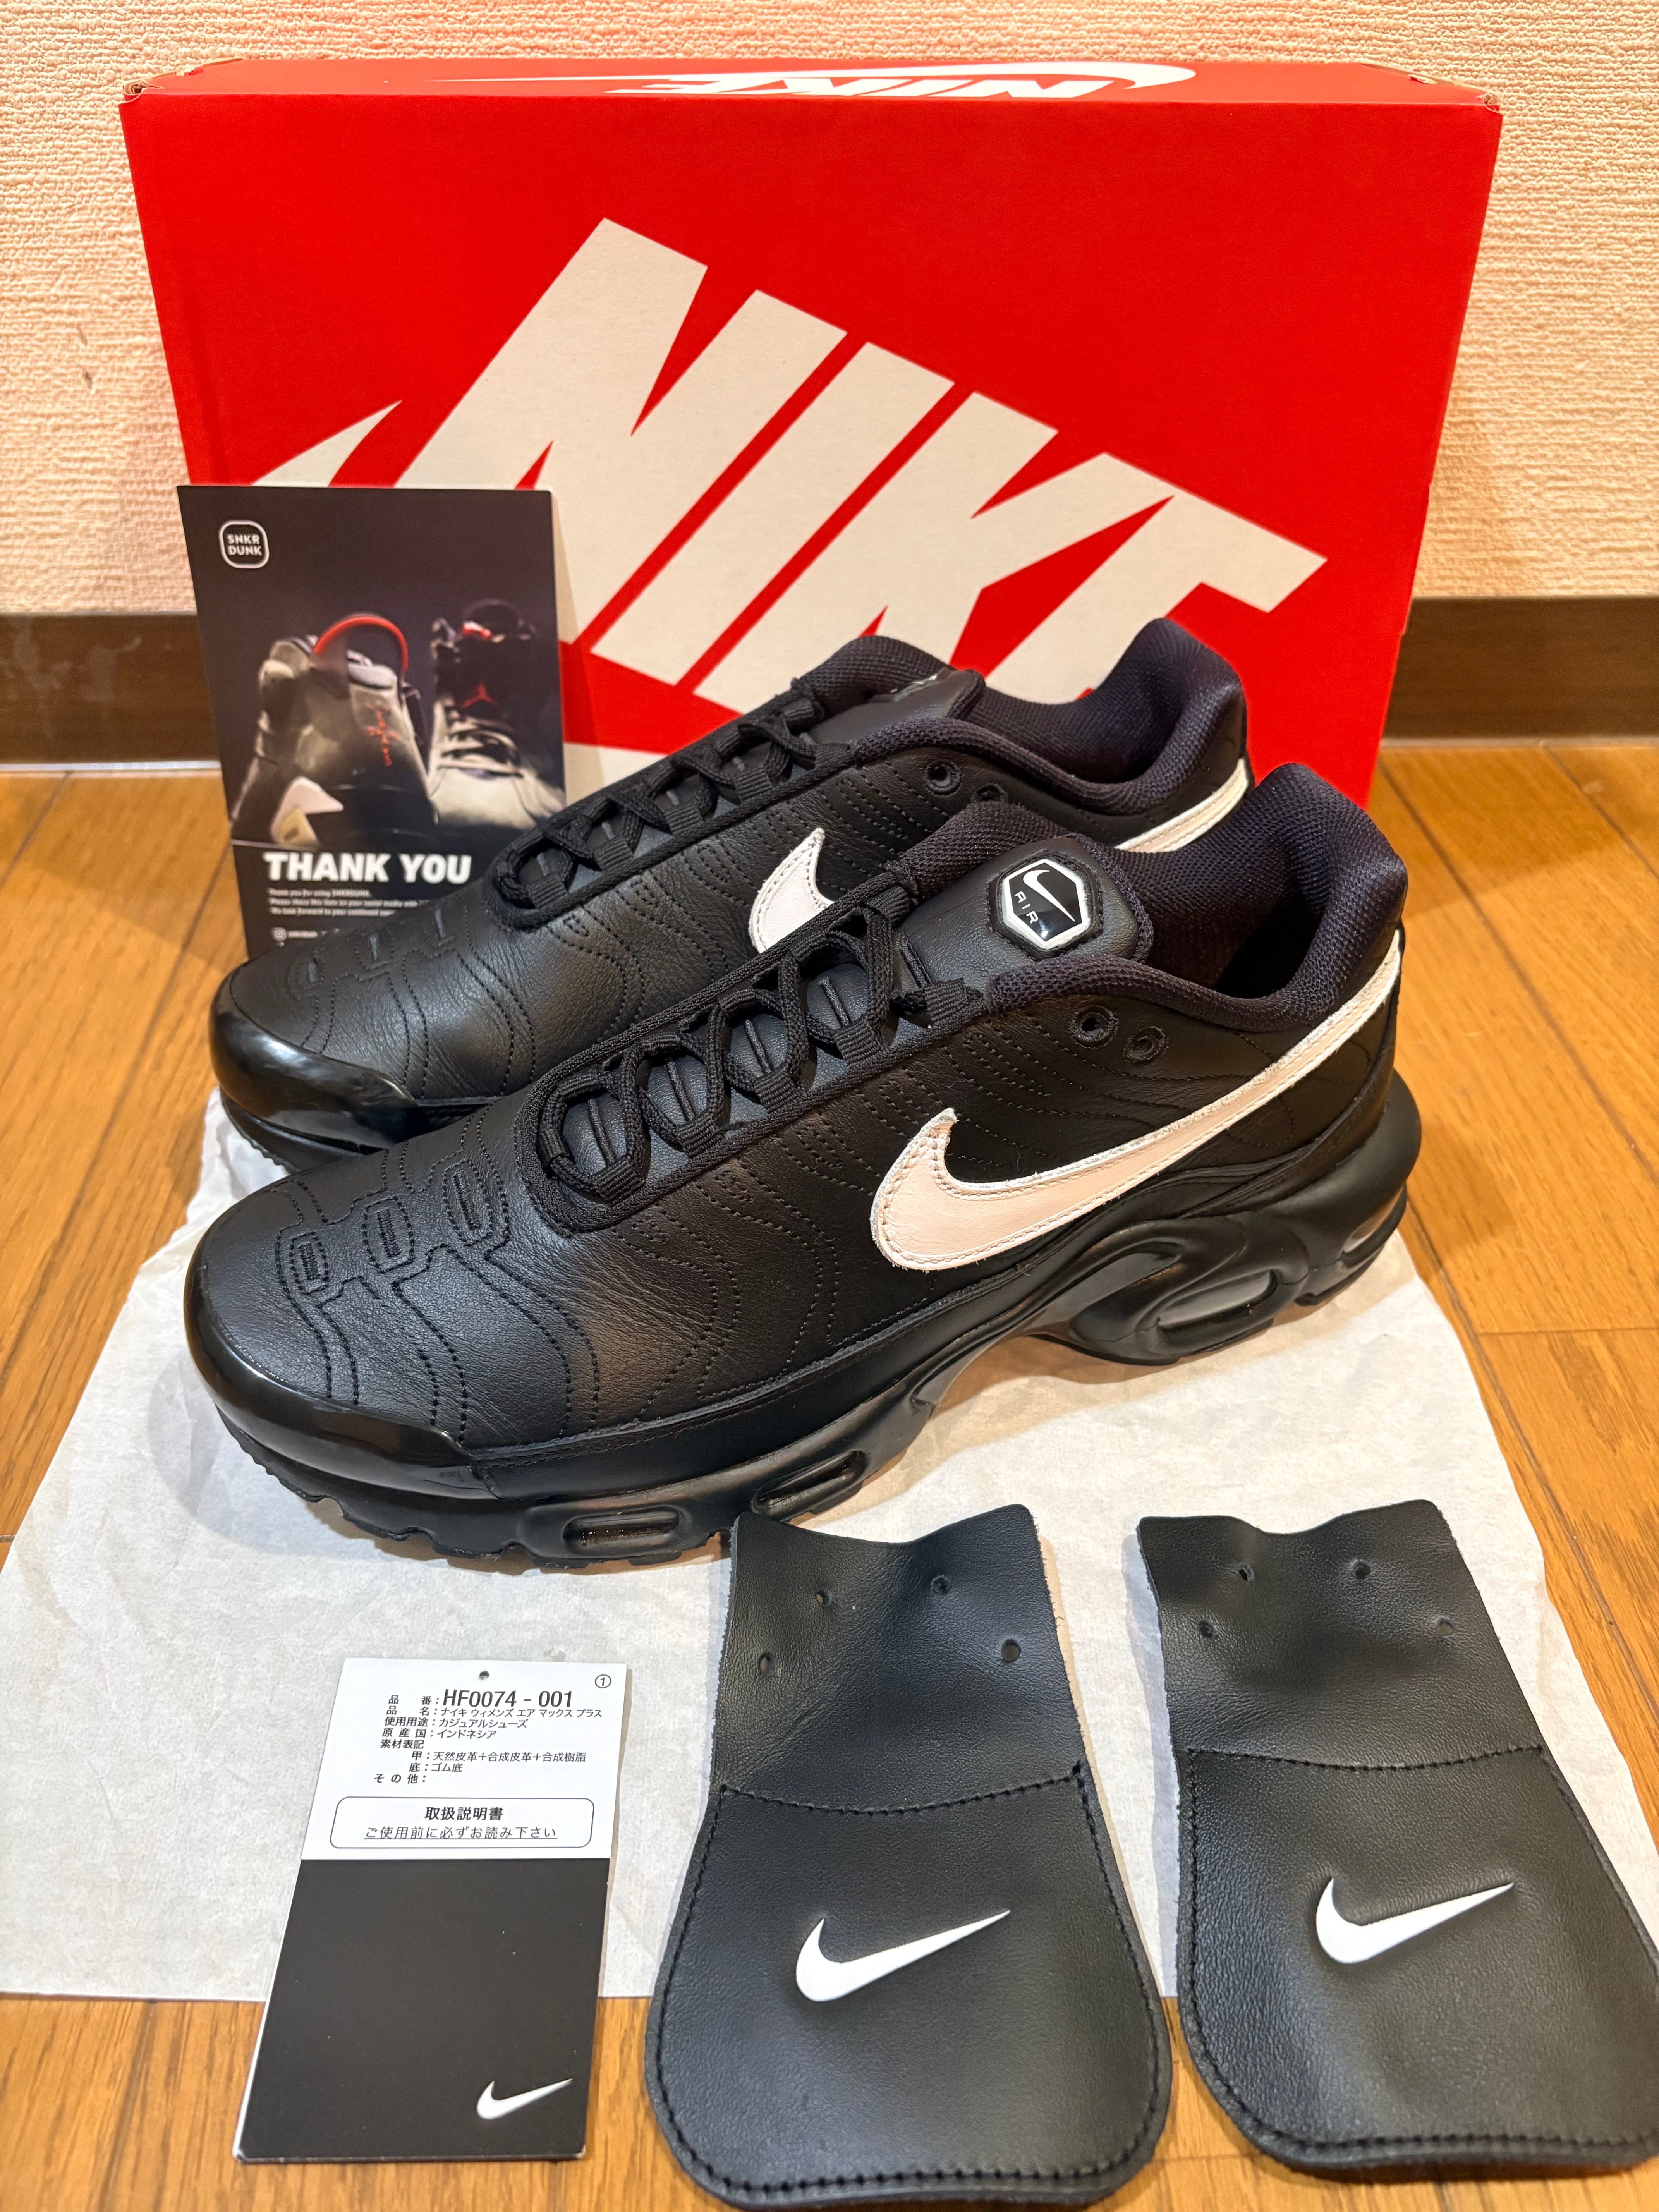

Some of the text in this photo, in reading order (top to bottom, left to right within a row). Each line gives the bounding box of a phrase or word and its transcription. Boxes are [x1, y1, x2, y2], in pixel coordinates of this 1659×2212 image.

[603, 77, 1114, 98] NIKE
[227, 534, 259, 544] SNKR
[228, 545, 262, 556] DUNK
[264, 851, 472, 884] THANK YOU
[1014, 891, 1039, 924] AIR
[443, 1689, 517, 1707] HF0074
[539, 1690, 572, 1707] 001
[380, 1739, 424, 1749] 素材表記
[424, 1807, 503, 1820] 取扱説明書
[365, 1826, 556, 1839] ご使用前に必ずお読み下さい
